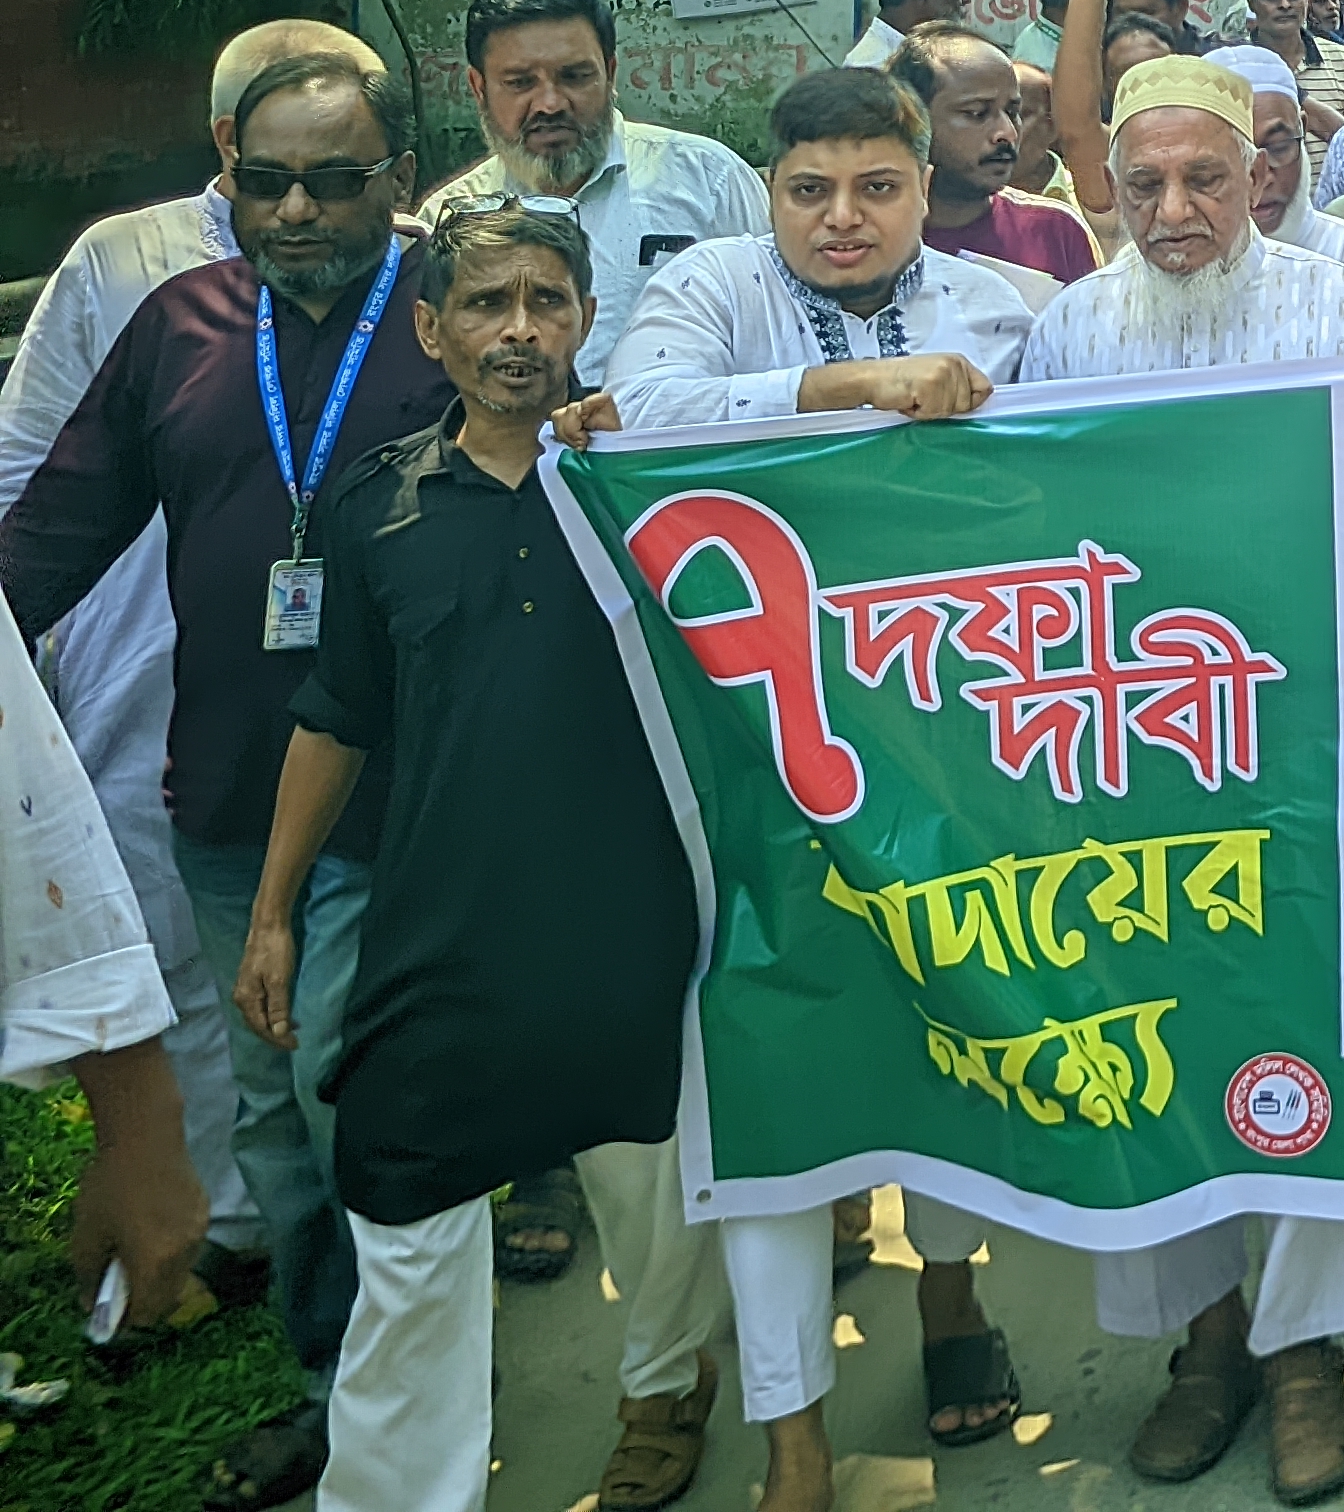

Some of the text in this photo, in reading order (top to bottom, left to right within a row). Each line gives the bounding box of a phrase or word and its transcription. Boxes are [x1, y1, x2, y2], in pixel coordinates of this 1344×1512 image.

[624, 489, 1144, 824] ৭ দফা
[962, 607, 1287, 803] দাবী
